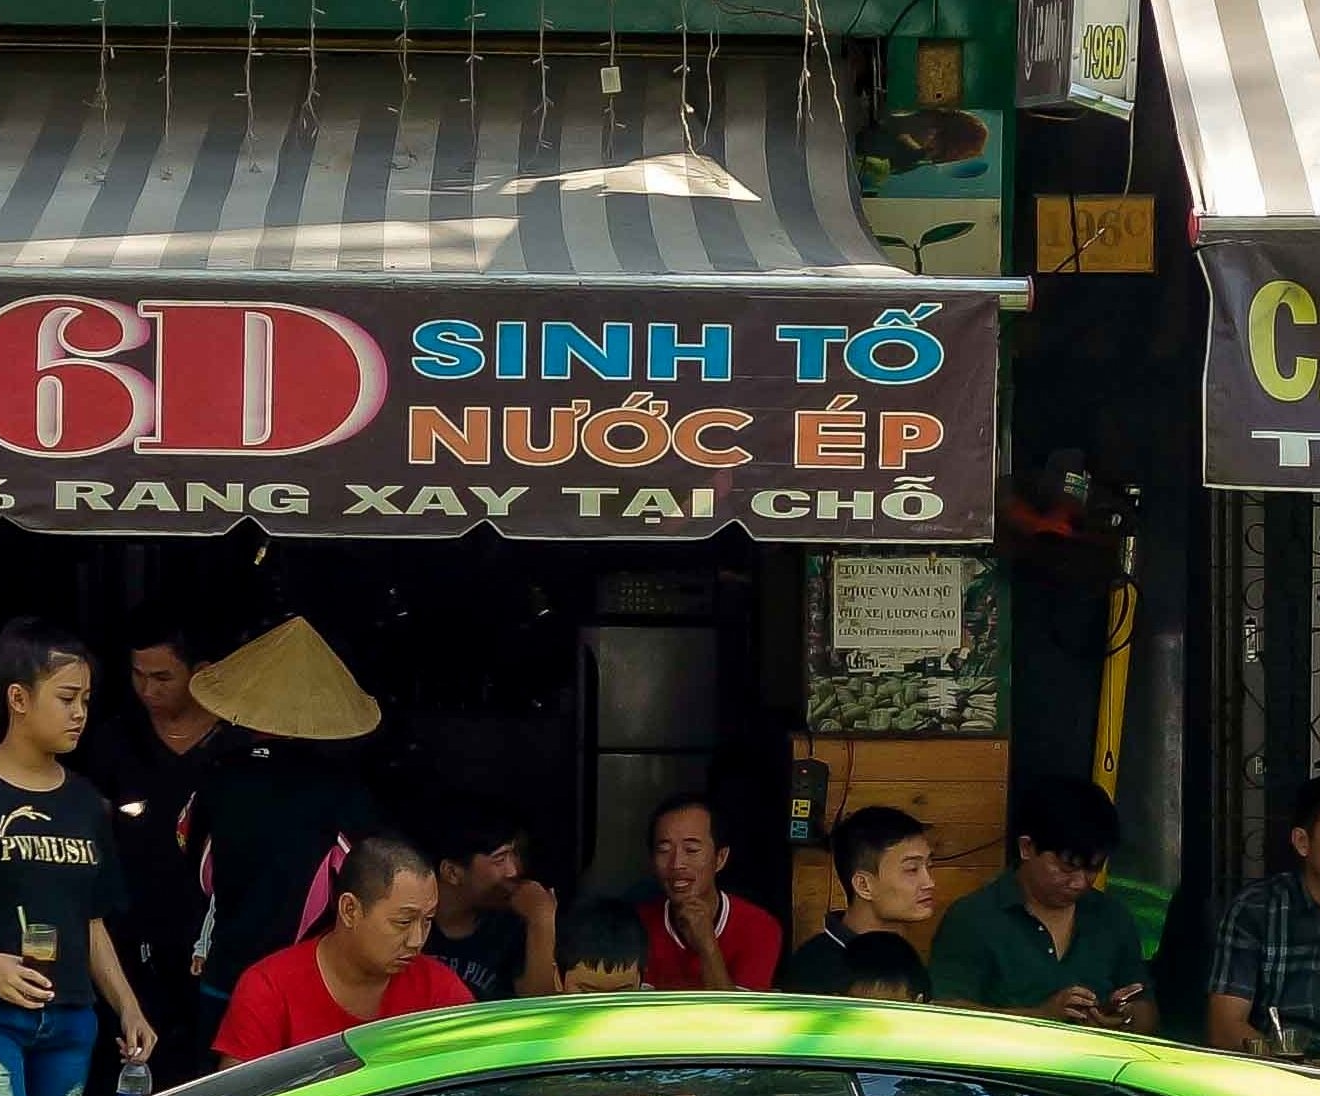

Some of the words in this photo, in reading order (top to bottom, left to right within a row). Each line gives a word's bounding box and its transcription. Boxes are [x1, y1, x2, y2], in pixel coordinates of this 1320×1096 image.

[1083, 24, 1126, 80] 196D
[411, 320, 732, 383] SINH
[776, 303, 945, 385] TỐ
[408, 392, 753, 468] NƯỚC
[793, 395, 944, 470] ÉP
[54, 480, 311, 515] RANG
[342, 484, 530, 518] XAY
[562, 486, 714, 524] TẠI
[750, 476, 944, 521] CHỖ
